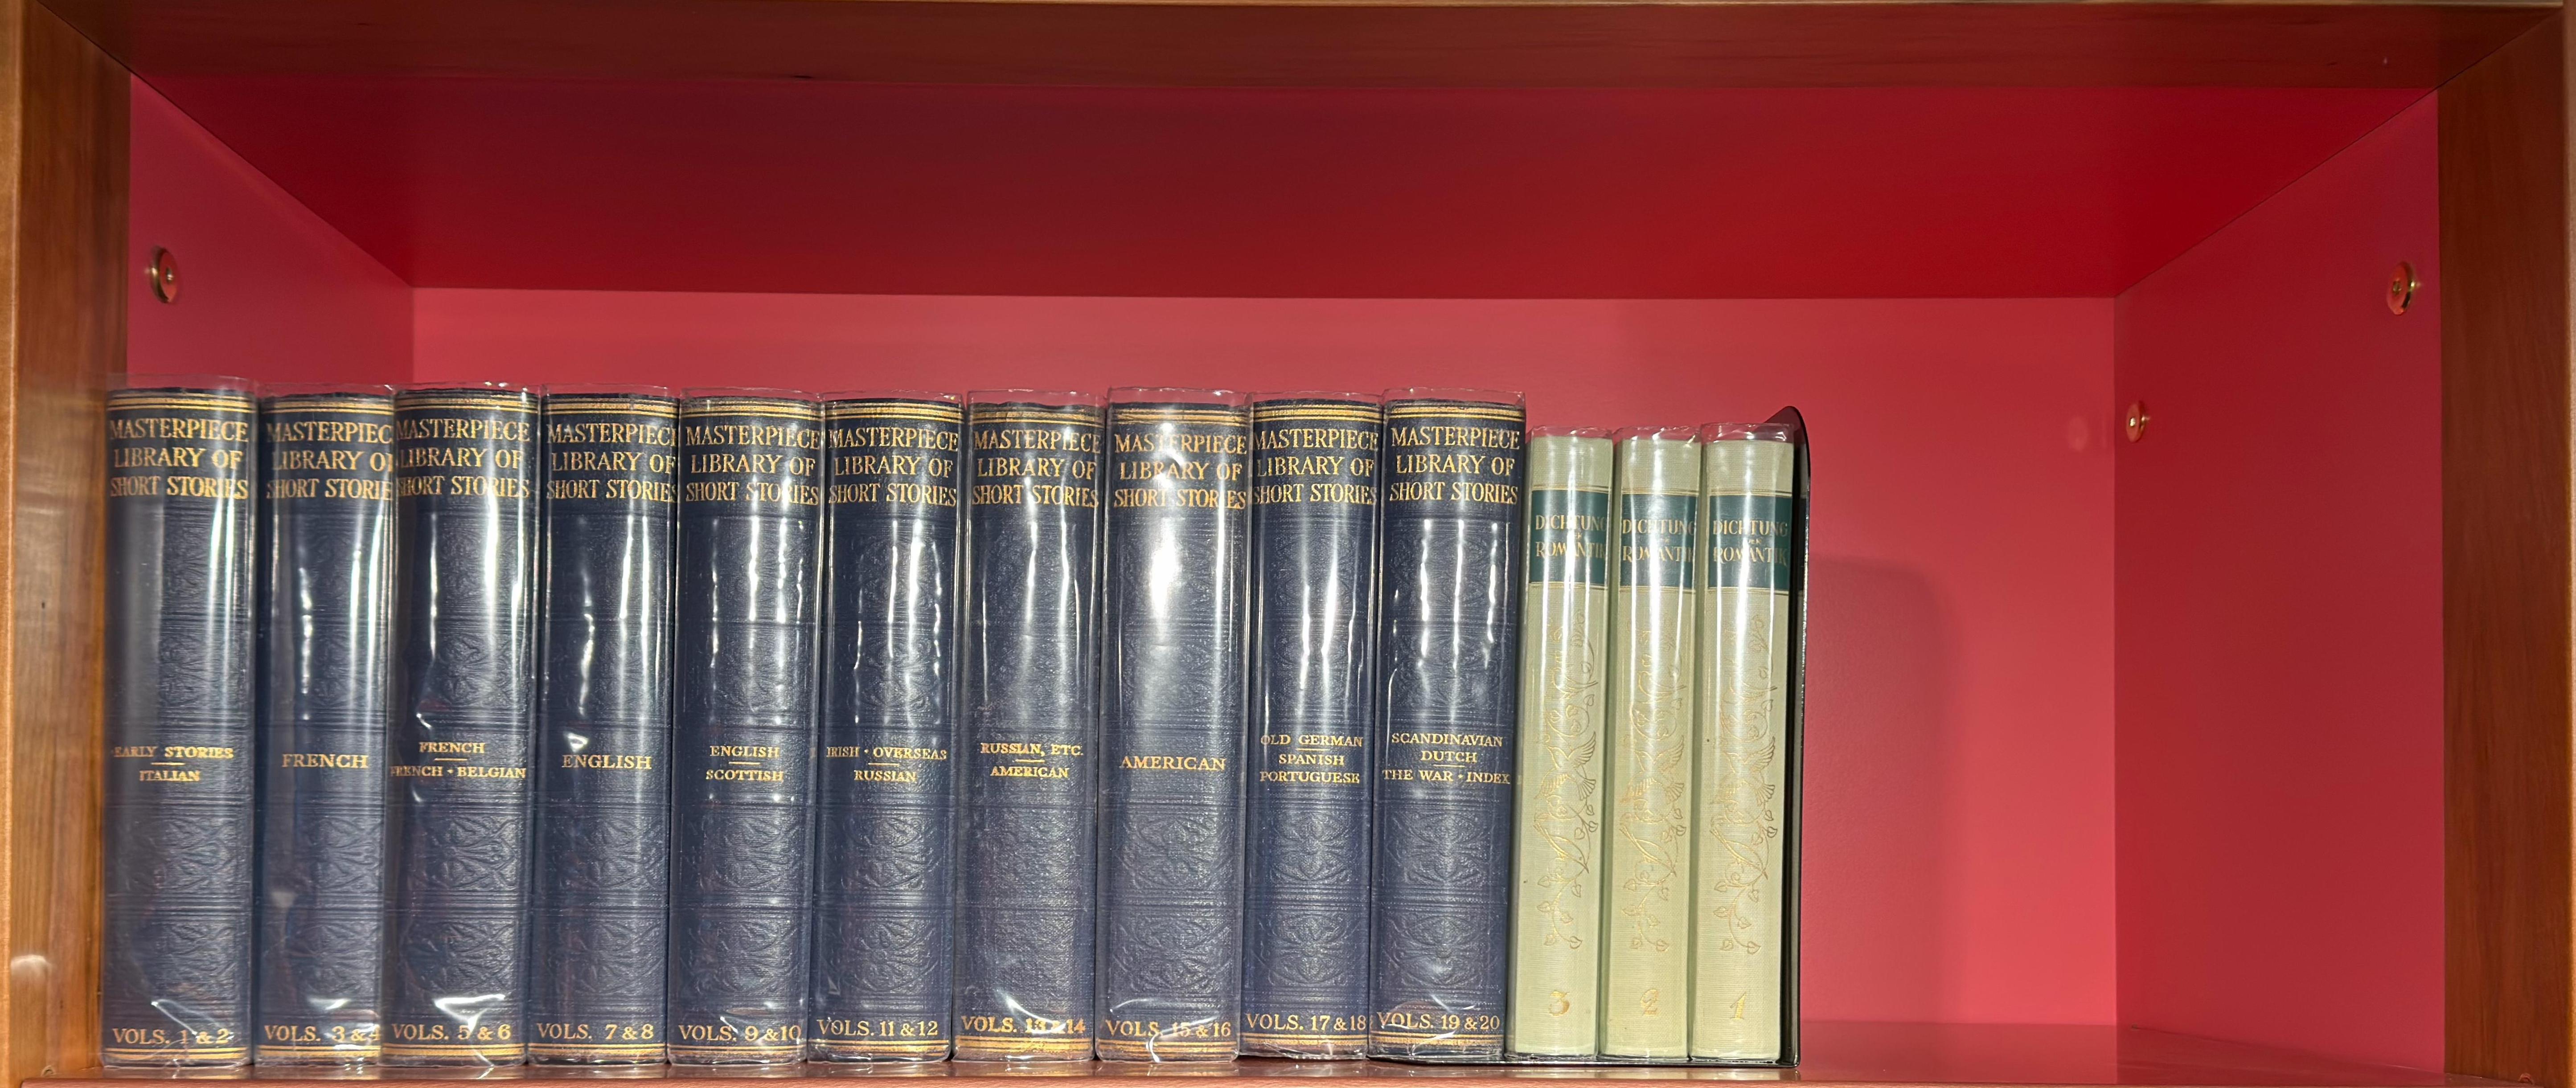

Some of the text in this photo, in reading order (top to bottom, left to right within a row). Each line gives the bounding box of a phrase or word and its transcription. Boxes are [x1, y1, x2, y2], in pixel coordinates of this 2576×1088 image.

[110, 418, 249, 442] MASTERPIECE
[267, 421, 393, 444] MASTERPIEC
[397, 418, 530, 442] MASTERPIECE
[685, 425, 820, 450] MASTERPIECE
[829, 426, 958, 452] MASTERPIECE
[1253, 428, 1378, 452] MASTERPIECE
[1391, 426, 1520, 450] MASTERPIECE
[973, 429, 1101, 454] MASTERPIECE
[1114, 433, 1247, 454] MASTERPIECE
[114, 447, 243, 469] LIBRARY OF
[272, 450, 365, 470] LIBRARY
[399, 447, 524, 469] LIBRARY OF
[551, 451, 676, 474] LIBRARY OF
[691, 454, 816, 476] LIBRARY OF
[834, 455, 953, 478] LIBRARY OF
[1257, 456, 1374, 477] LIBRARY OF
[1396, 454, 1515, 476] LIBRARY OF
[977, 457, 1097, 480] LIBRARY OF
[1120, 461, 1243, 481] LIBRARY OF
[111, 476, 248, 499] SHORT STORIES
[267, 478, 393, 500] SHORT STORIE
[397, 475, 530, 499] SHORT STORIES
[546, 479, 600, 499] SHORT
[685, 482, 740, 502] SHORT
[829, 483, 956, 507] SHORT STORIES
[972, 484, 1099, 508] SHORT STORIES
[1253, 483, 1377, 505] SHORT STORIES
[1390, 482, 1518, 504] SHORT STORIES
[1114, 488, 1167, 508] SHORT
[419, 742, 485, 753] FRENCH
[980, 743, 1084, 757] RUSSIAN, ETC.
[1260, 734, 1363, 747] OLD GERMAN
[1391, 733, 1503, 747] SCANDINAVIAN
[113, 746, 234, 759] EARLY STORIES
[282, 753, 369, 769] FRENCH
[562, 754, 652, 769] ENGLISH
[710, 745, 780, 758] ENGLISH
[826, 746, 947, 760] IRISH OVERSEAS
[1279, 754, 1345, 765] SPANISH
[1420, 750, 1477, 763] DUTCH
[390, 765, 526, 778] FRENCH BELGIAN
[990, 766, 1070, 778] AMERICAN
[1119, 756, 1226, 770] AMERICAN
[139, 770, 201, 781] ITALIAN
[706, 769, 784, 782] SCOTTISH
[853, 770, 916, 781] RUSSIAN
[1259, 771, 1360, 784] PORTUGUESE
[1382, 769, 1511, 784] THE WAR INDEX
[1548, 990, 1570, 1017] 3
[1640, 989, 1659, 1016] 2
[1730, 992, 1747, 1020] 1
[816, 1019, 938, 1036] VOLS. 11 & 12
[961, 1015, 1017, 1033] VOLS.
[1066, 1018, 1085, 1034] 14
[1196, 1025, 1209, 1038] &
[1213, 1022, 1231, 1037] 16
[1245, 1013, 1304, 1031] VOLS.
[1311, 1015, 1331, 1031] 17
[1350, 1015, 1366, 1031] 18
[1377, 1011, 1500, 1030] VOLS. 19 & 20
[112, 1028, 230, 1044] VOLS. 1 & 2
[264, 1025, 321, 1041] VOLS.
[332, 1026, 345, 1042] 3
[351, 1029, 366, 1041] &
[392, 1023, 511, 1040] VOLS. 5 & 6
[605, 1024, 619, 1040] 7
[622, 1027, 638, 1040] &
[641, 1023, 654, 1039] 8
[678, 1025, 737, 1042] VOLS.
[744, 1025, 758, 1042] 9
[781, 1025, 802, 1041] 10
